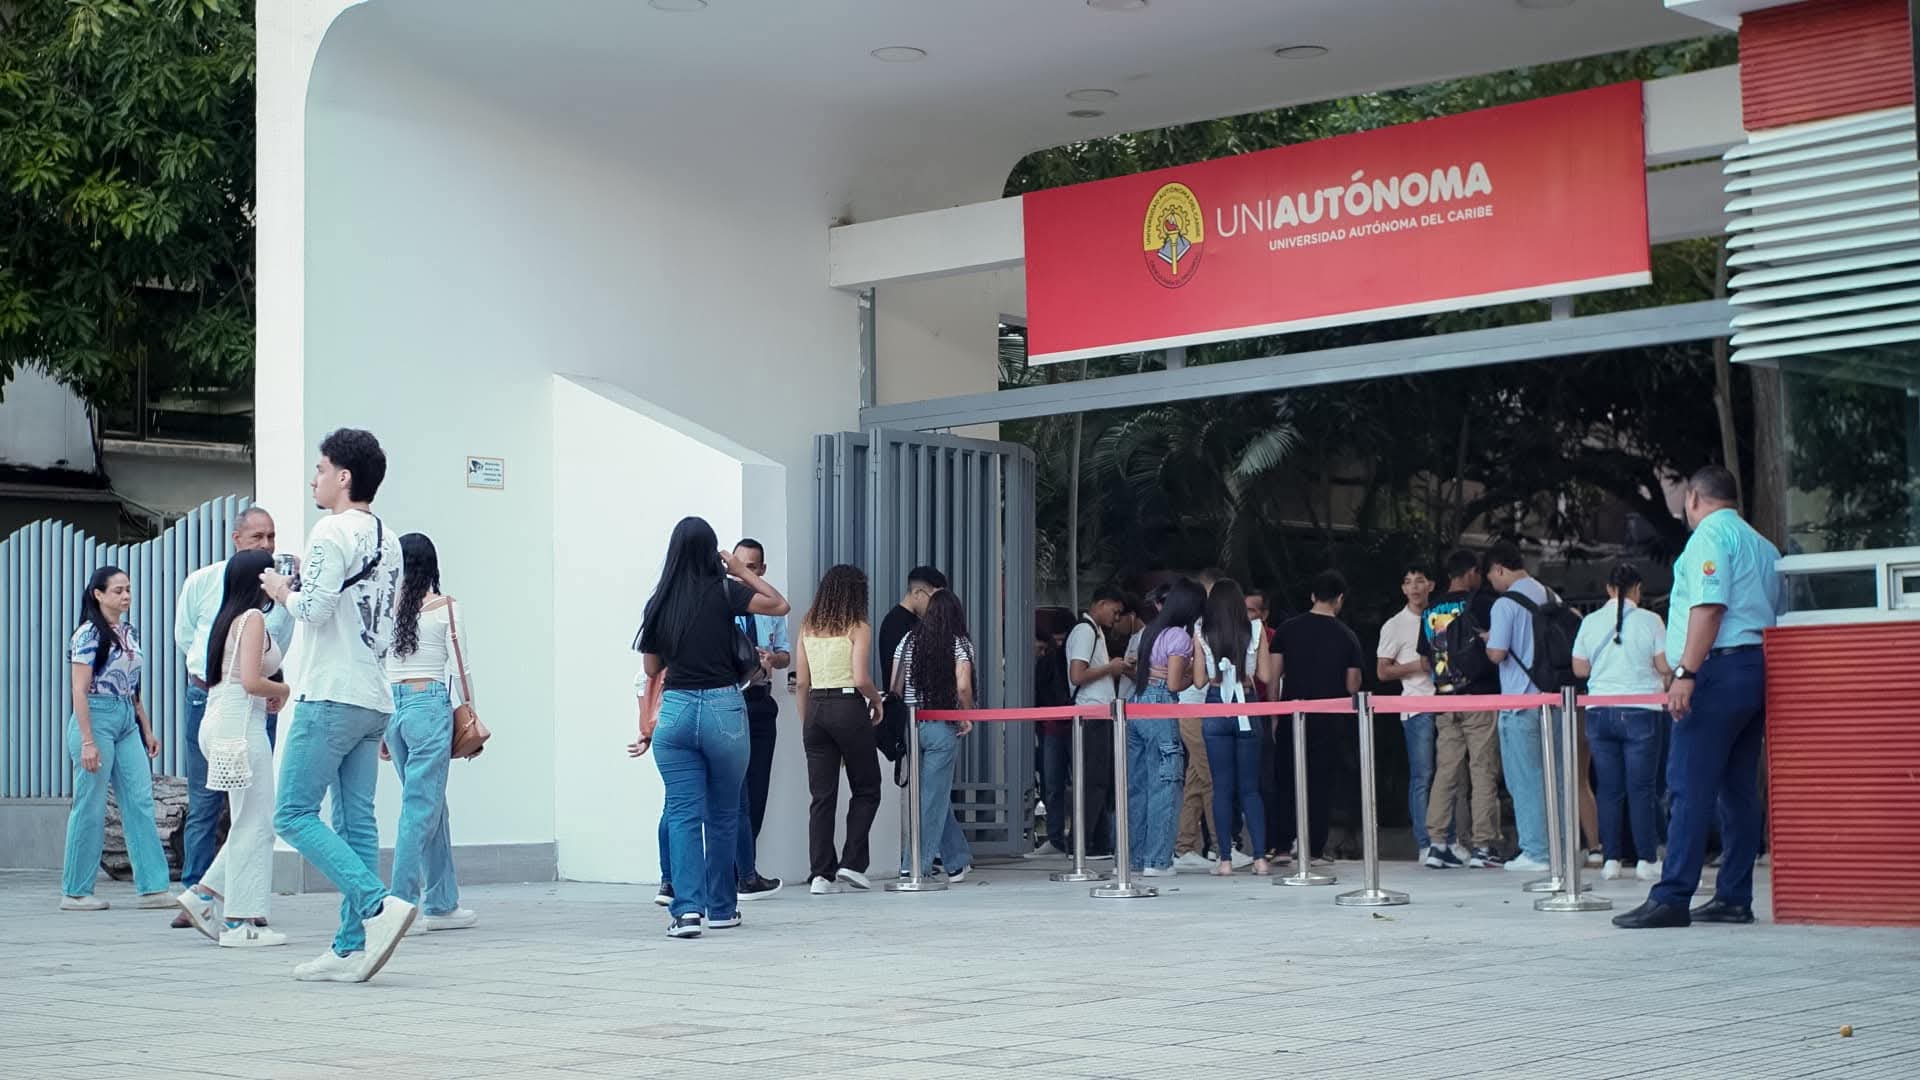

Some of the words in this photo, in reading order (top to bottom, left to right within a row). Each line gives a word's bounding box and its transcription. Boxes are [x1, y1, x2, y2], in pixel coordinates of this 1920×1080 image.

[1216, 161, 1493, 238] UNIAUTÓNOMA
[1269, 228, 1346, 251] UNIVERSIDAD
[1348, 217, 1418, 240] AUTÓNOMA
[1420, 212, 1444, 228] DEL
[1447, 204, 1493, 222] CARIBE
